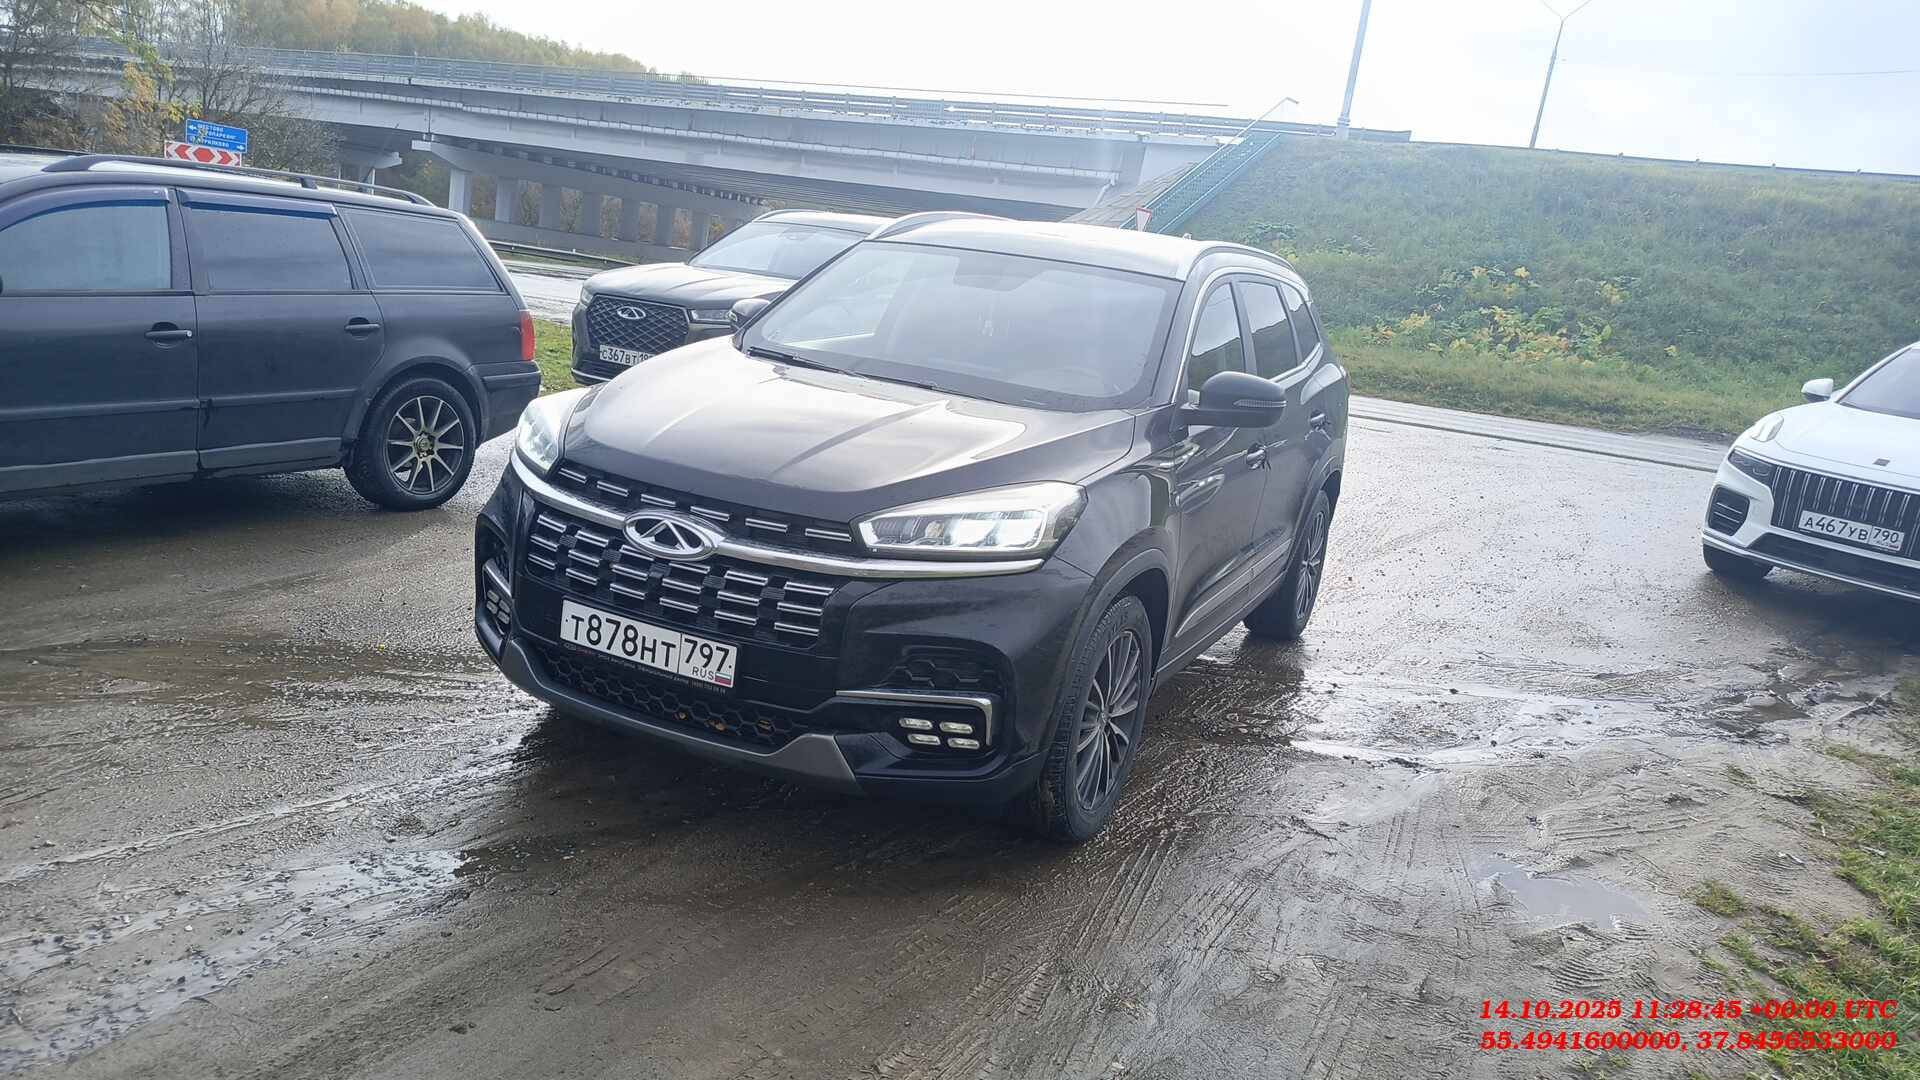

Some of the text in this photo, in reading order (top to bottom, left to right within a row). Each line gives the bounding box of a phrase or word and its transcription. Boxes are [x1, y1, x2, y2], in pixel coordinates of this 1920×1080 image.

[602, 348, 654, 365] С367ВТ 19
[1804, 516, 1899, 543] А467УВ 790
[571, 614, 677, 668] Т878НТ
[684, 638, 730, 672] 797
[692, 666, 714, 681] RUS
